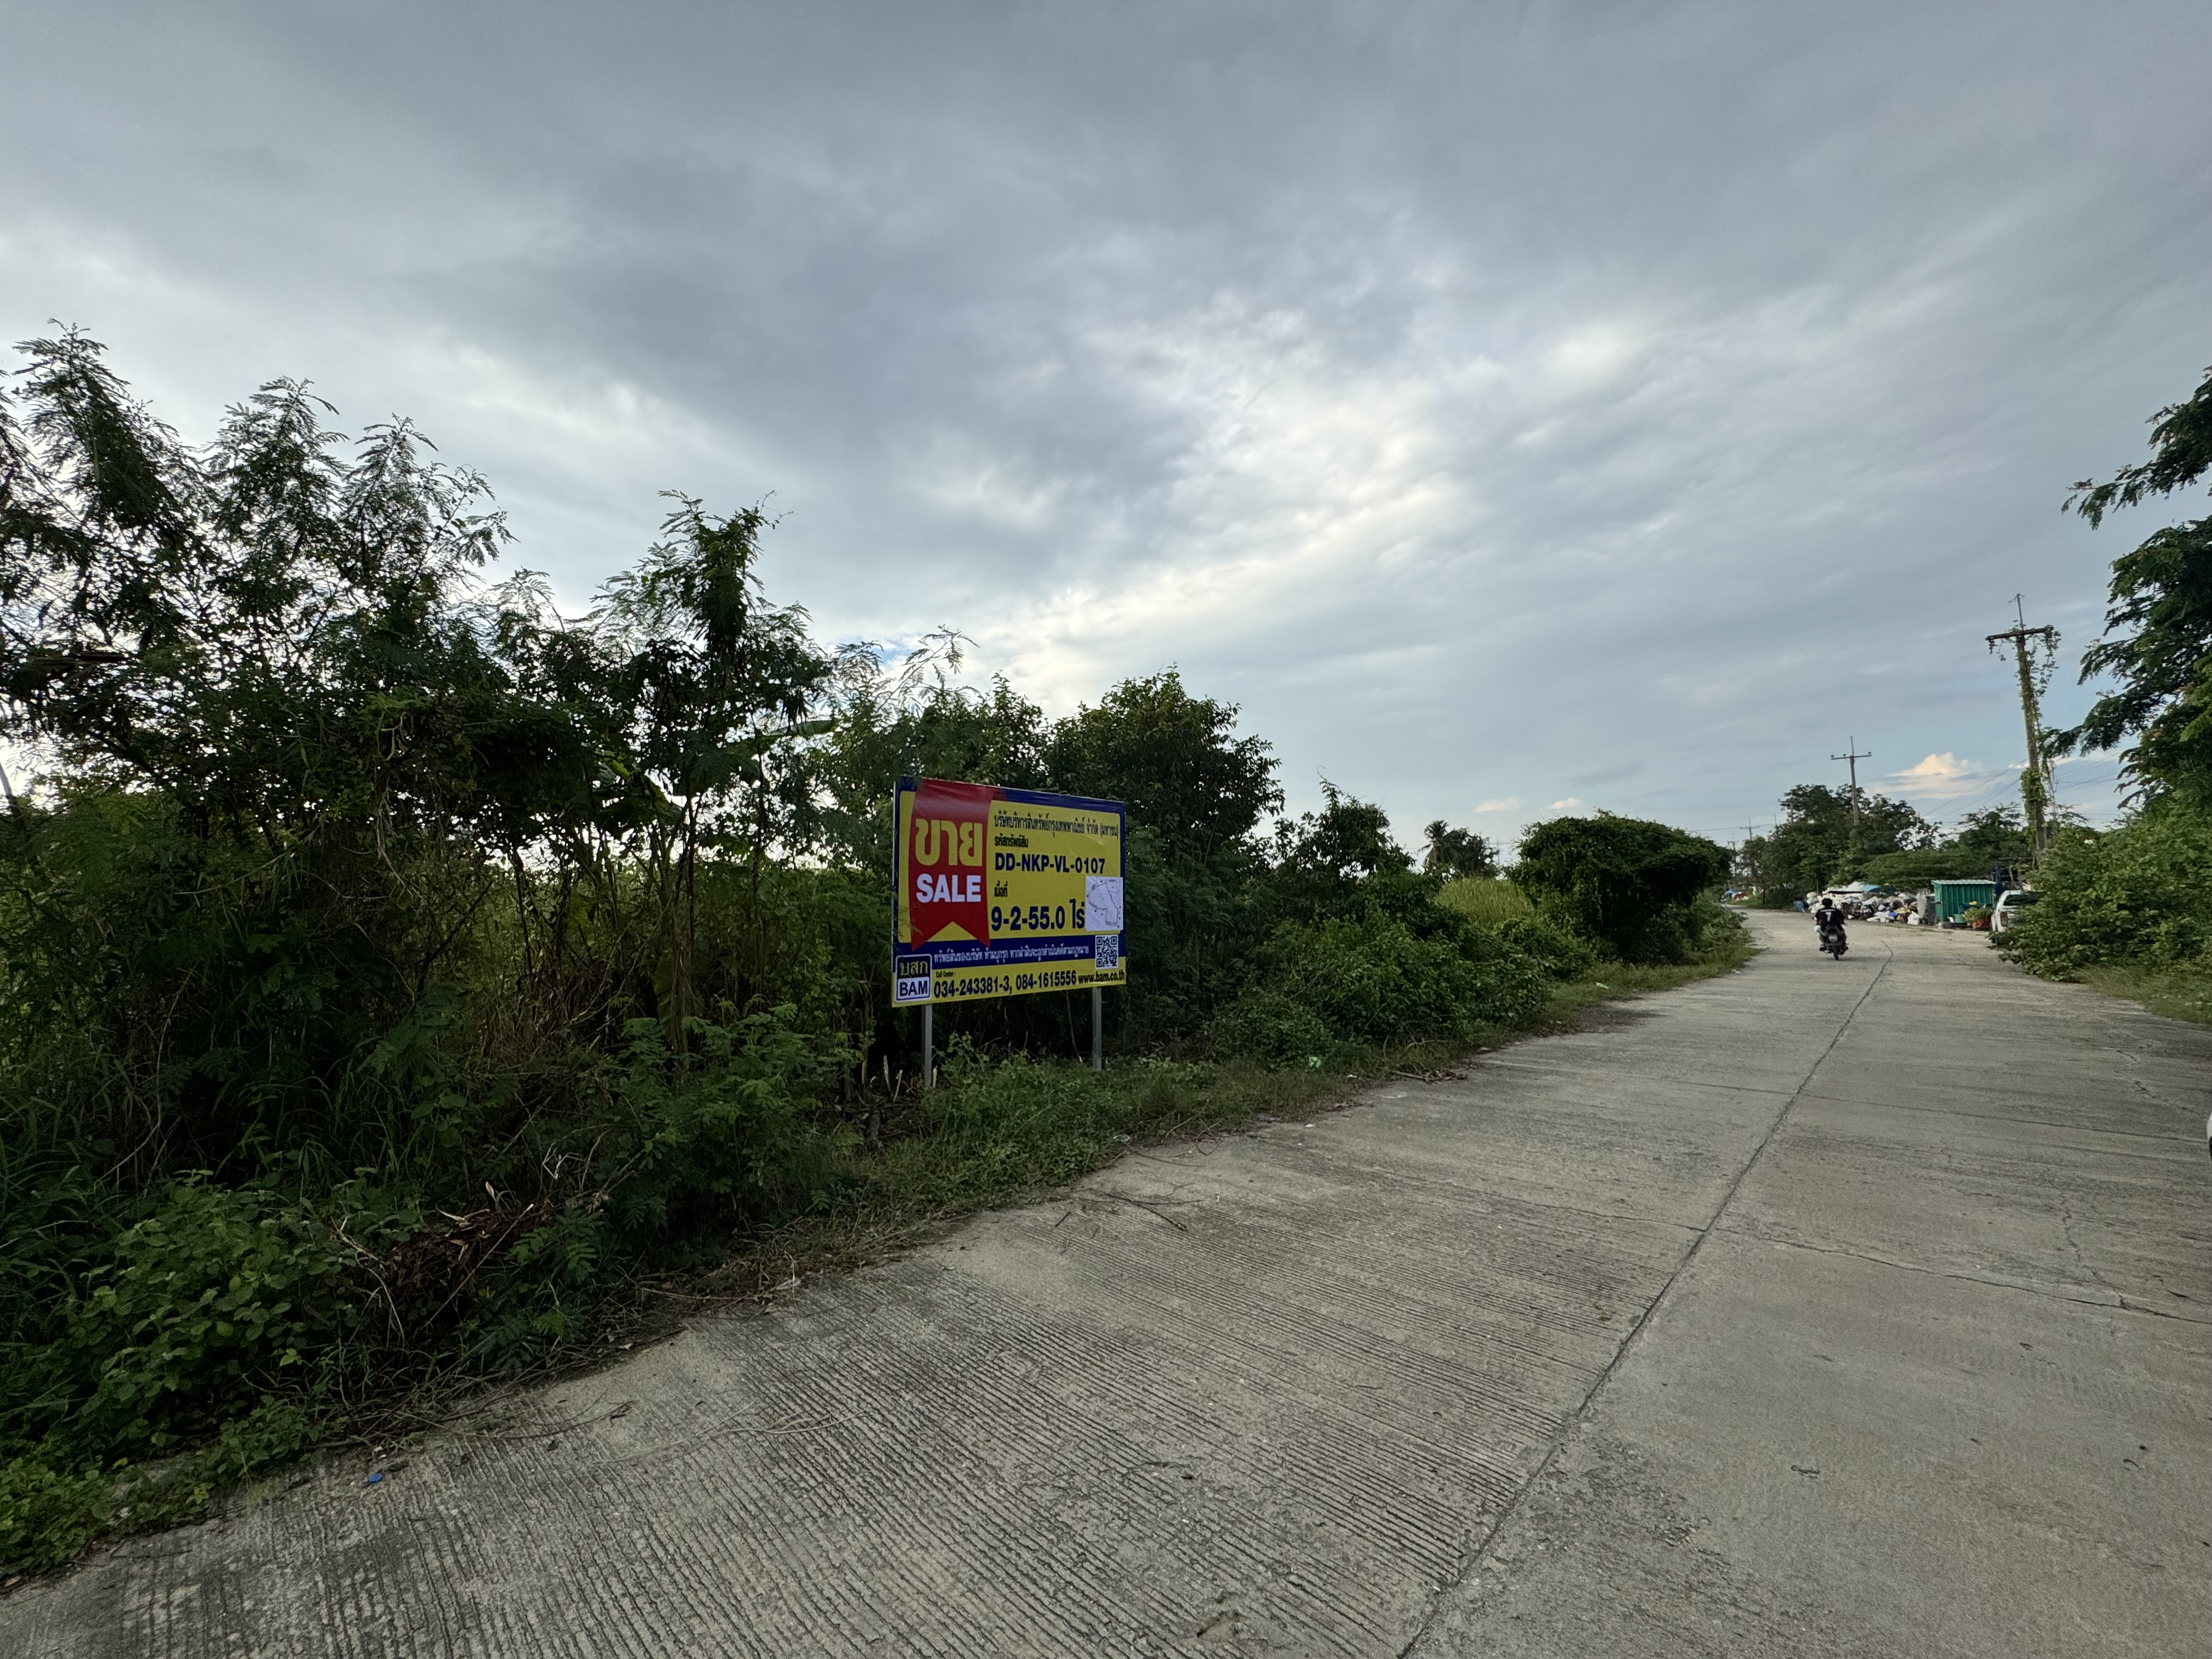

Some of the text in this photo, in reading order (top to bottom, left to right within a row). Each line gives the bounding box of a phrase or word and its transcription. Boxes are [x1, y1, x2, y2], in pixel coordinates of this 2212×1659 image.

[1086, 817, 1099, 834] จำกัด
[1100, 822, 1119, 840] (มหาชน)
[915, 818, 983, 867] ขาย
[994, 832, 1029, 848] รหัสทรัพย์สิน
[995, 852, 1105, 874] DD-NKP-VL-0107
[916, 873, 981, 904] SALE
[994, 879, 1008, 898] เนื้อที่
[991, 898, 1085, 932] 9-2-55.0 ไร่
[934, 947, 983, 963] ทรัพย์สินของบริษัท
[899, 961, 928, 975] บสก
[900, 980, 928, 996] BAM
[934, 970, 1125, 998] 034-243381-3, 084-1615556 www.bam.co.th
